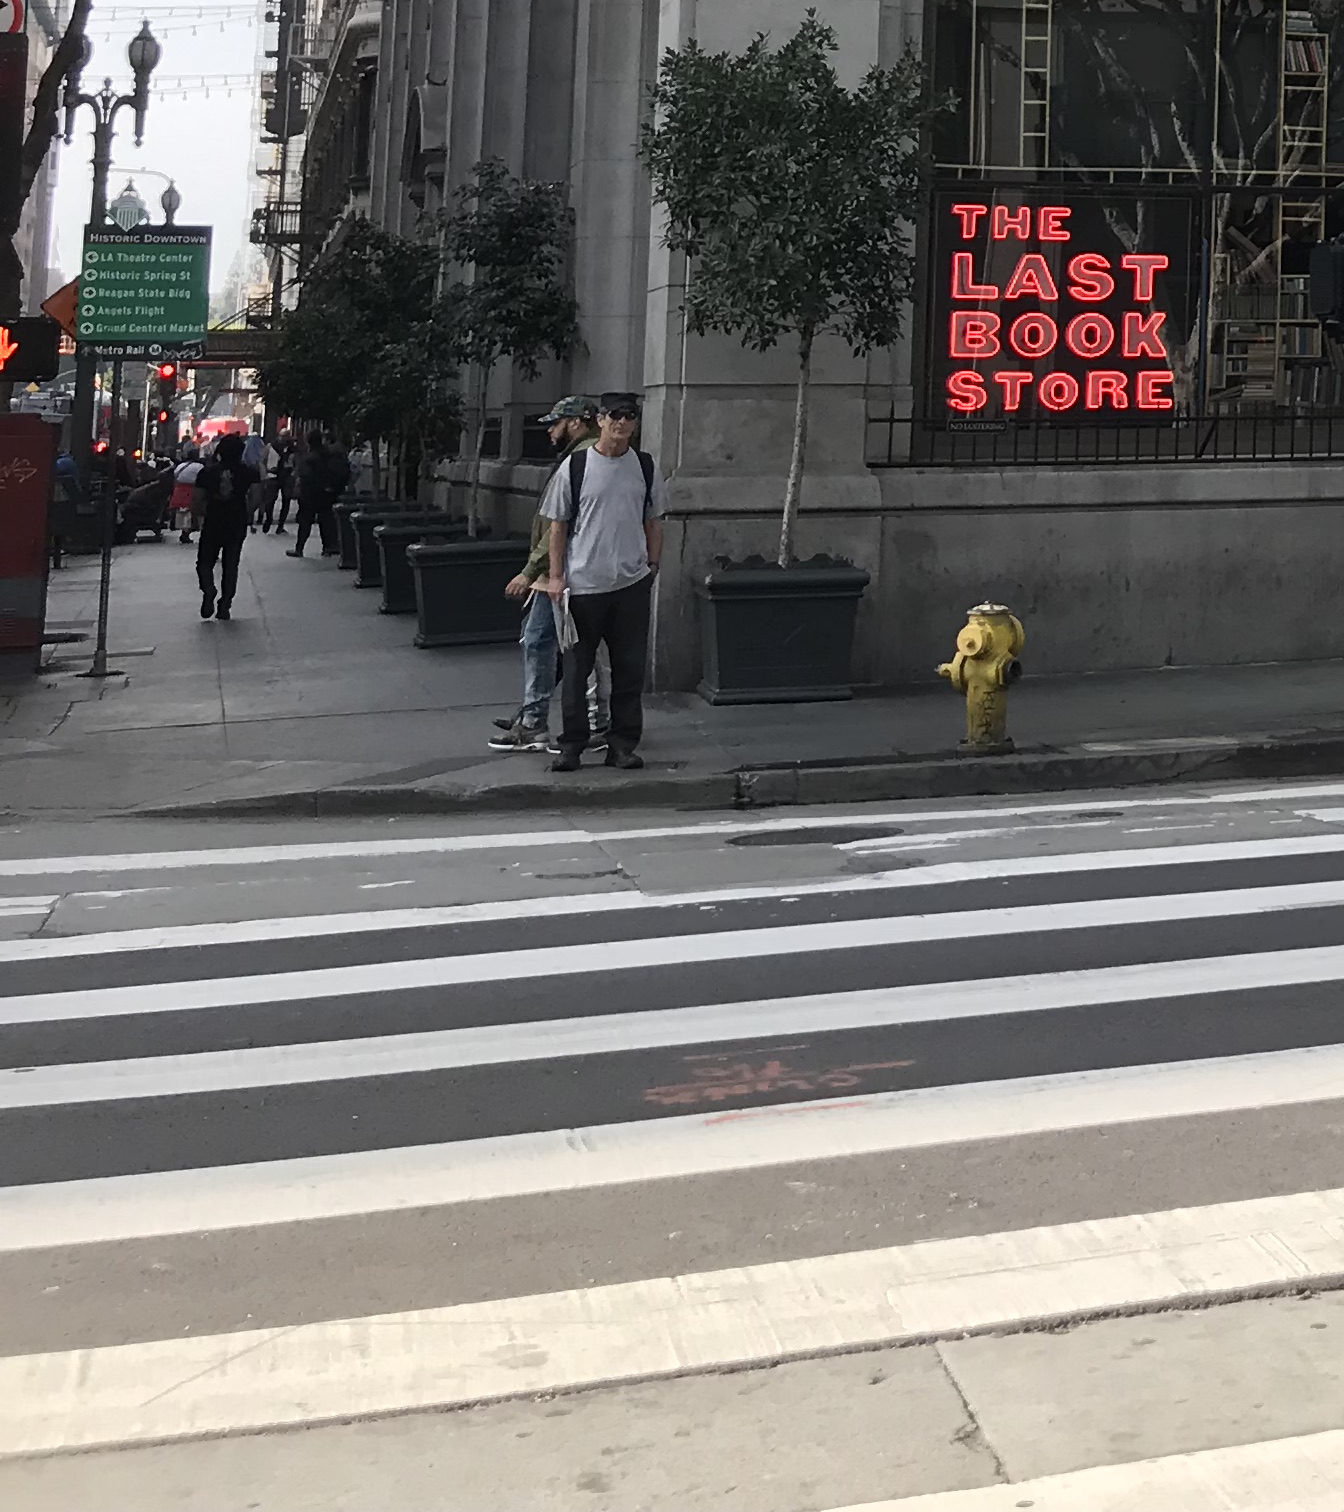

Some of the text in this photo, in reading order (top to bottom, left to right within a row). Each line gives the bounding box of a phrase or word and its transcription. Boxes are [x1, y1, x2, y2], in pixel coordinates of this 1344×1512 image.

[951, 202, 1072, 242] THE
[100, 252, 193, 263] LA Theatre Center
[99, 270, 192, 282] Historic Spring St
[951, 251, 1170, 302] LAST
[98, 287, 191, 300] Reagan State Bldg
[97, 306, 165, 317] Angels Flight
[96, 323, 204, 333] Grand Central Market
[948, 310, 1168, 359] BOOK
[126, 345, 145, 355] Rail
[947, 369, 1175, 412] STORE
[950, 422, 964, 430] NO
